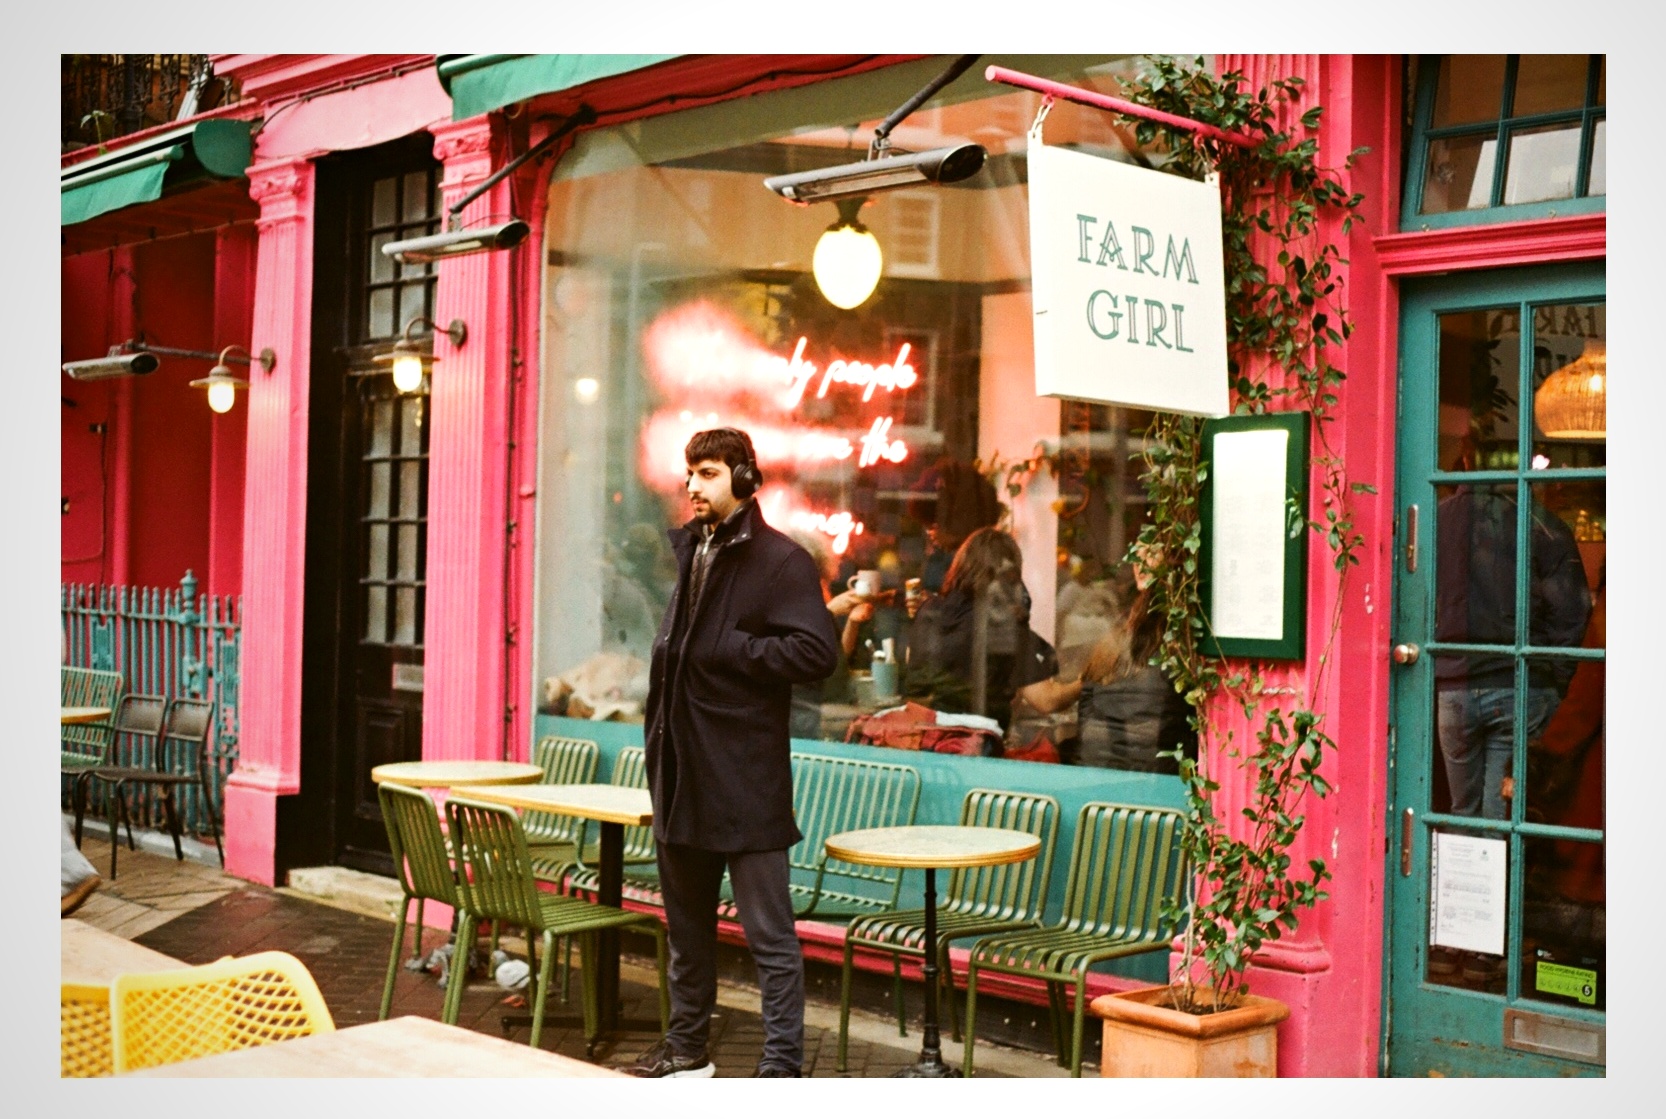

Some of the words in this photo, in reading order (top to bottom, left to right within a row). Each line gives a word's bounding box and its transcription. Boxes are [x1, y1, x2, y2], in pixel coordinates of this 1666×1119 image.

[1076, 213, 1199, 285] FARM
[1086, 289, 1194, 353] GIRL
[817, 343, 917, 402] people
[859, 416, 908, 468] the
[1583, 985, 1591, 996] 5
